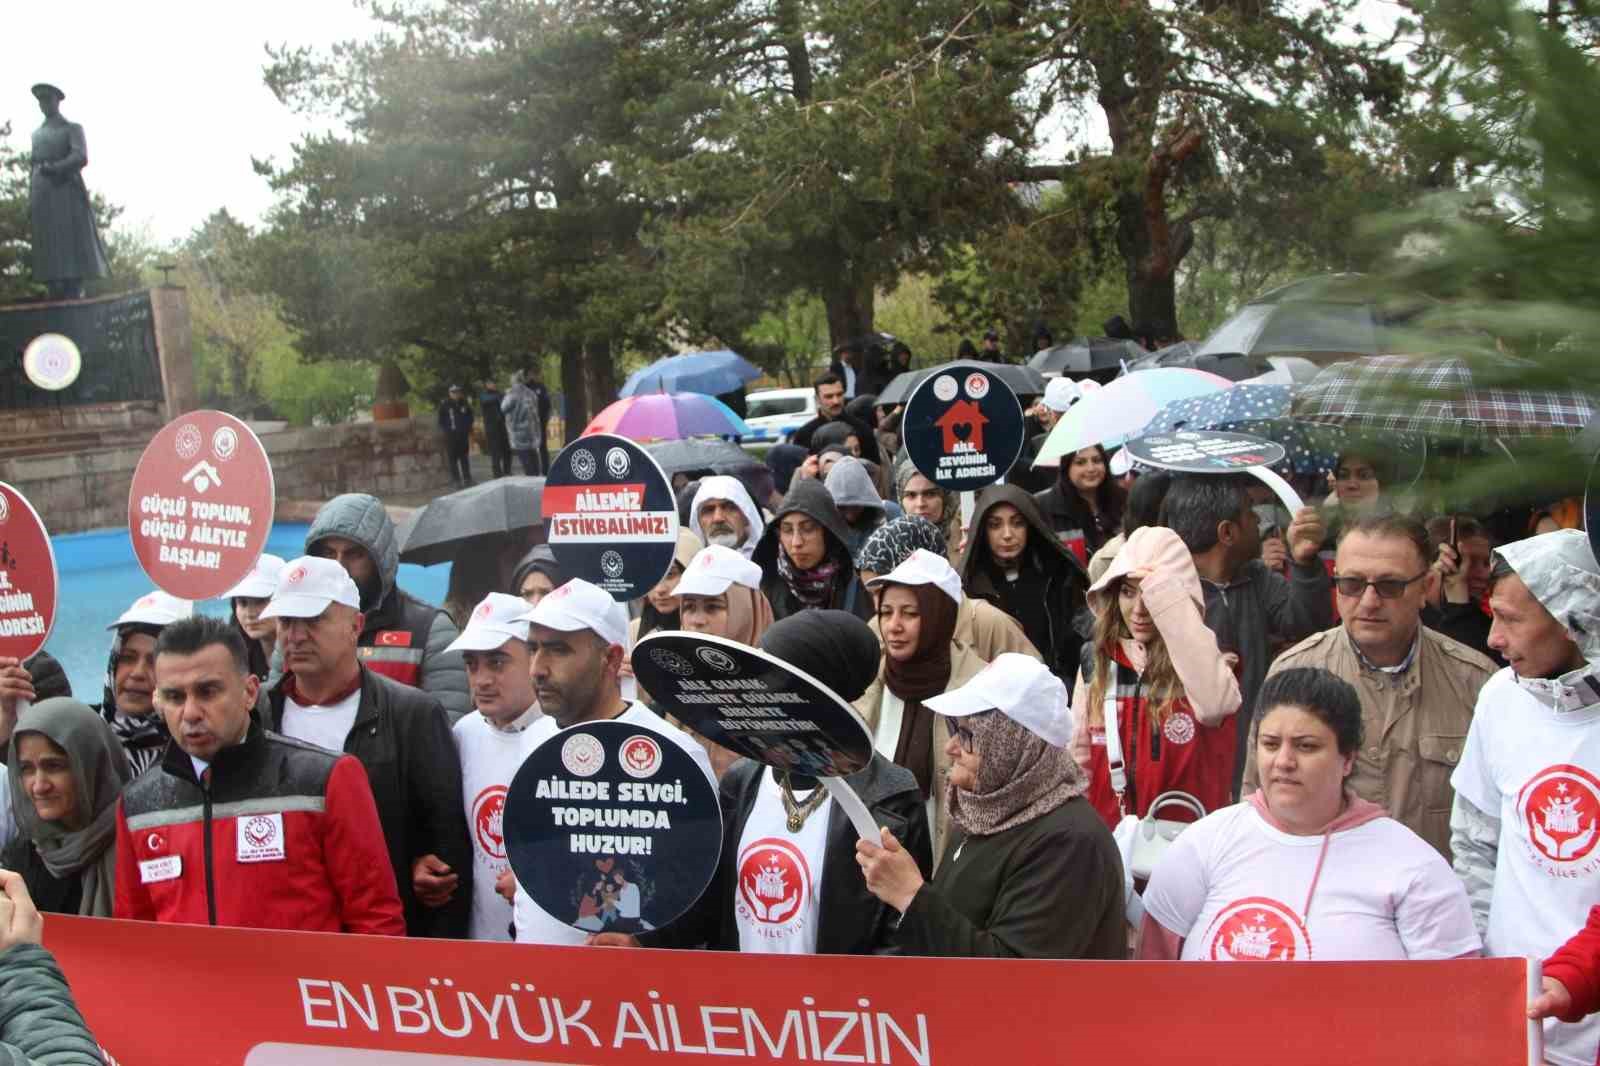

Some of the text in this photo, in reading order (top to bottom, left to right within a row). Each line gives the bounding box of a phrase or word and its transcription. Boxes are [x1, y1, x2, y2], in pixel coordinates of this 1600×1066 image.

[936, 463, 996, 480] İLK ADRESİ!
[141, 491, 252, 526] GÜÇLÜ TOPLUM,
[575, 487, 642, 511] AİLEMİZ
[141, 517, 247, 548] GÜÇLÜ AİLEYLE
[553, 512, 669, 535] İSTİKBALİMİZ!
[160, 545, 221, 571] BAŞLAR!
[535, 775, 688, 805] AİLEDE SEVGİ,
[551, 806, 671, 829] TOPLUMDA
[570, 833, 652, 855] HUZUR!
[297, 977, 931, 1066] EN BÜYÜK AİLEMİZİN
